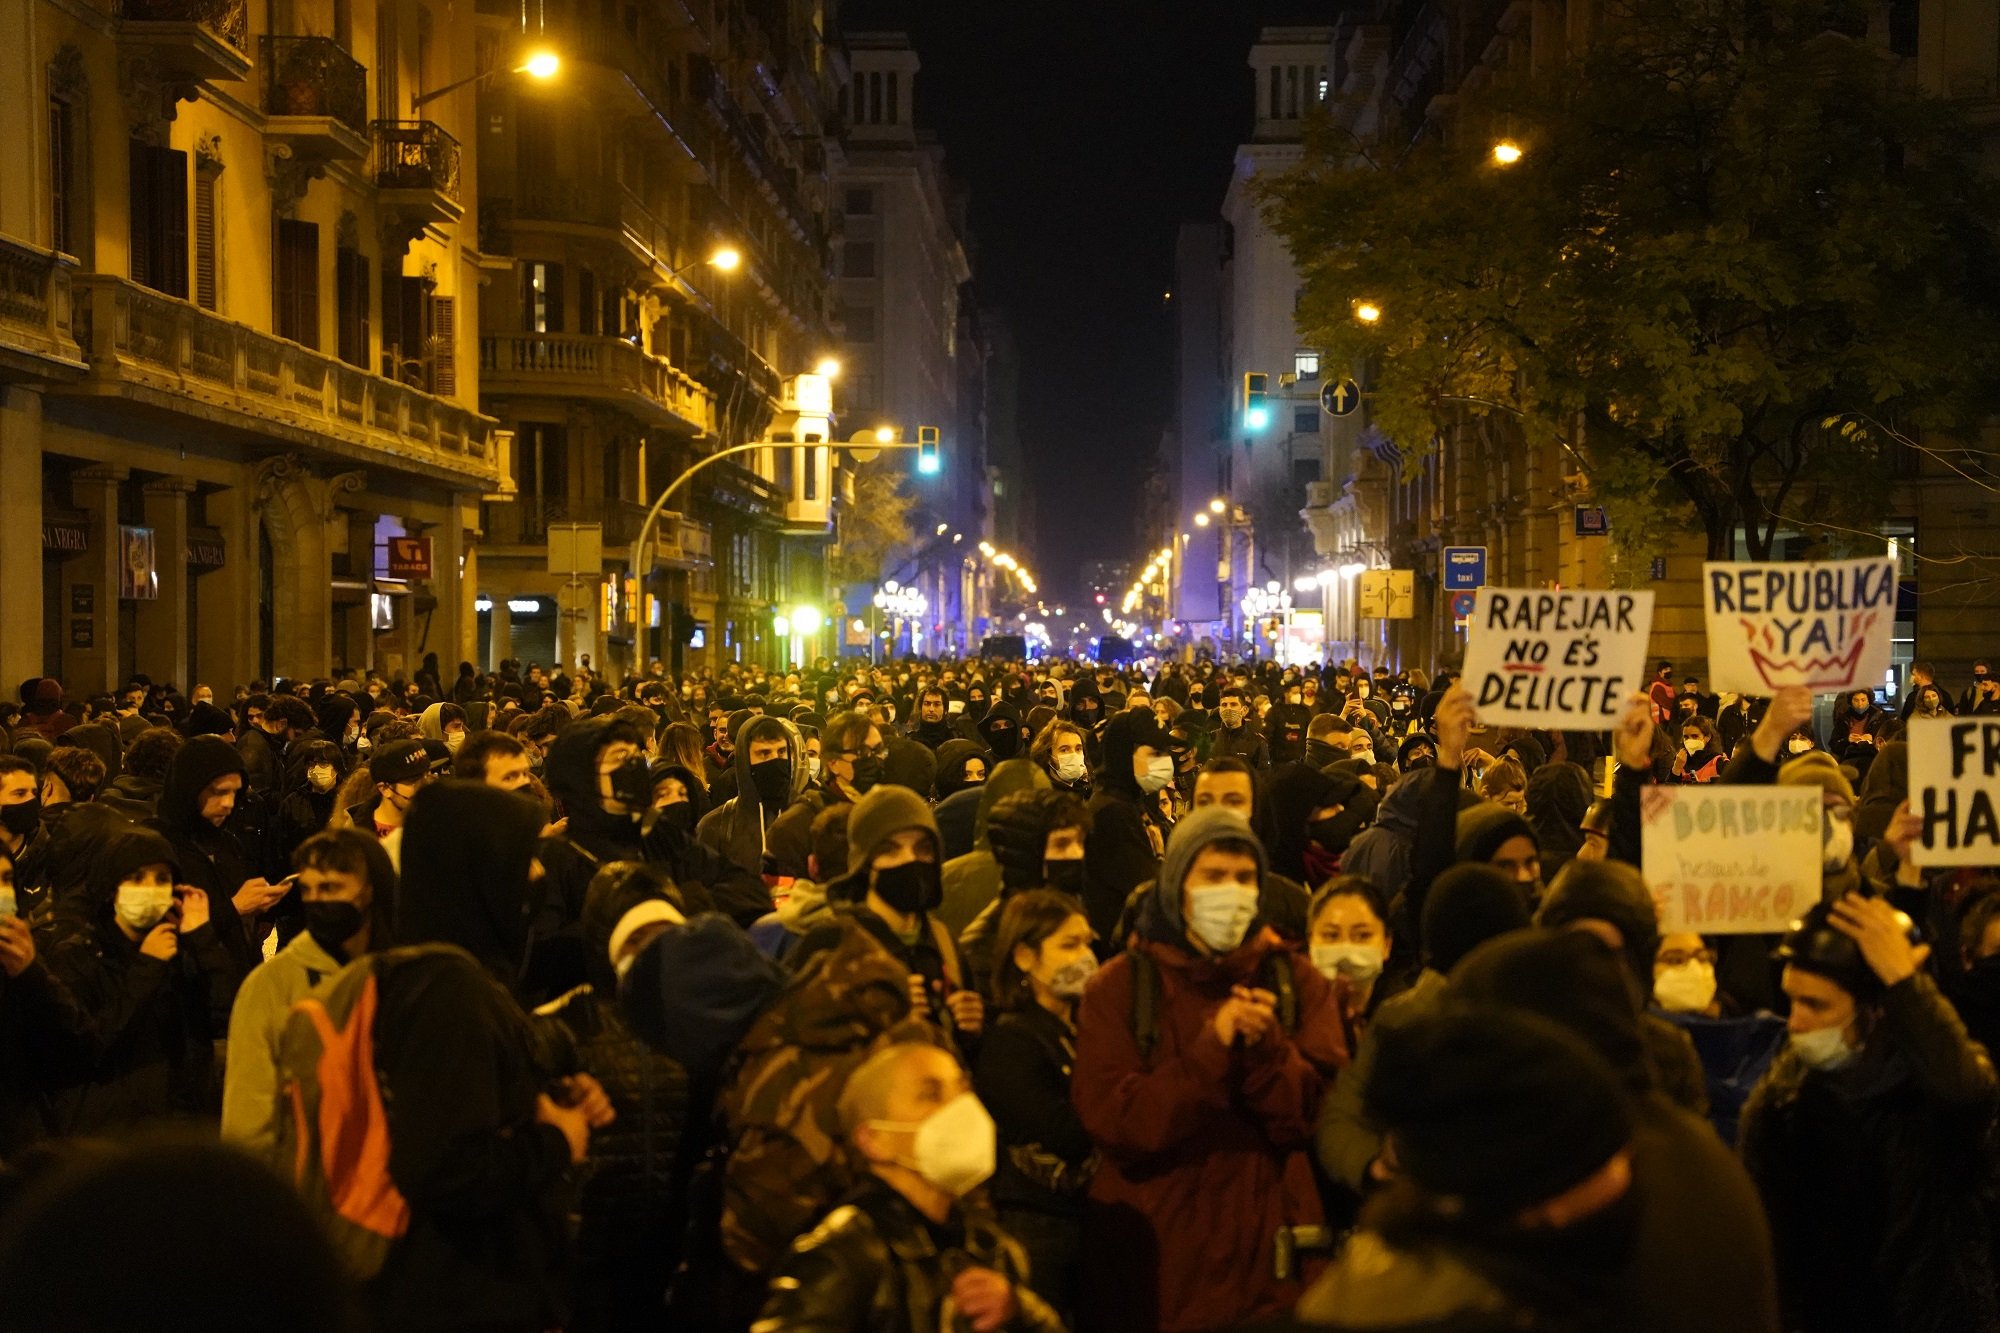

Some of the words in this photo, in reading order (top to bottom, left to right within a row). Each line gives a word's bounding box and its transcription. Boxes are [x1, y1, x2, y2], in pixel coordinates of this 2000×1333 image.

[54, 527, 87, 550] NEGRA
[198, 543, 224, 565] NEGRA
[1456, 573, 1473, 583] taxi
[1711, 564, 1893, 613] REPUBLICA
[1487, 594, 1635, 632] RAPEJAR
[1504, 639, 1549, 664] NO
[1772, 614, 1845, 655] YA!
[1477, 672, 1623, 715] DELICTE
[1921, 785, 2000, 850] HA
